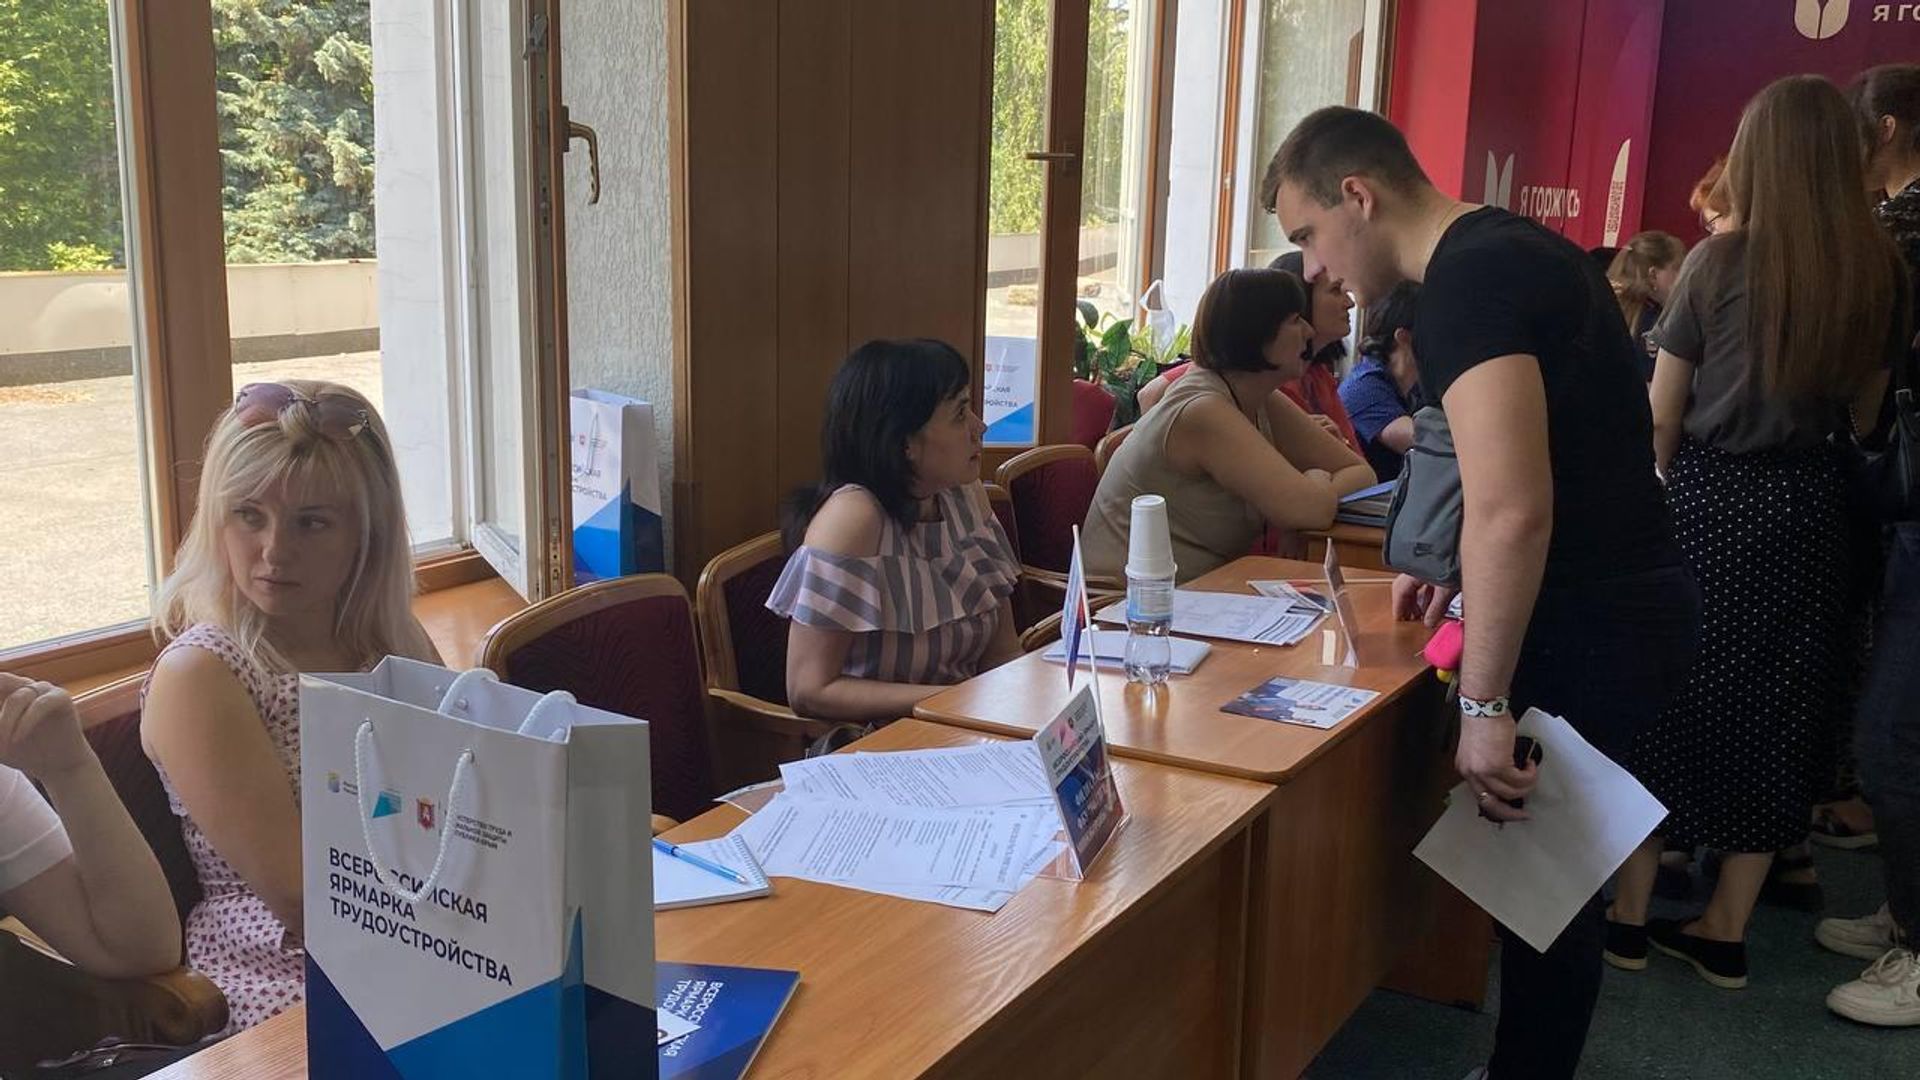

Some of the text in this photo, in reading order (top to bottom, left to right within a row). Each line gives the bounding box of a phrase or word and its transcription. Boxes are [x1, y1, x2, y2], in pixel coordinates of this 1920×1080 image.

[329, 847, 488, 923] ВСЕРСИСКАЯ
[329, 873, 416, 921] ЯРМАРКА
[329, 897, 513, 986] ТРУДОУСТРОЙСТВА
[674, 980, 707, 1019] ЯРМАРК
